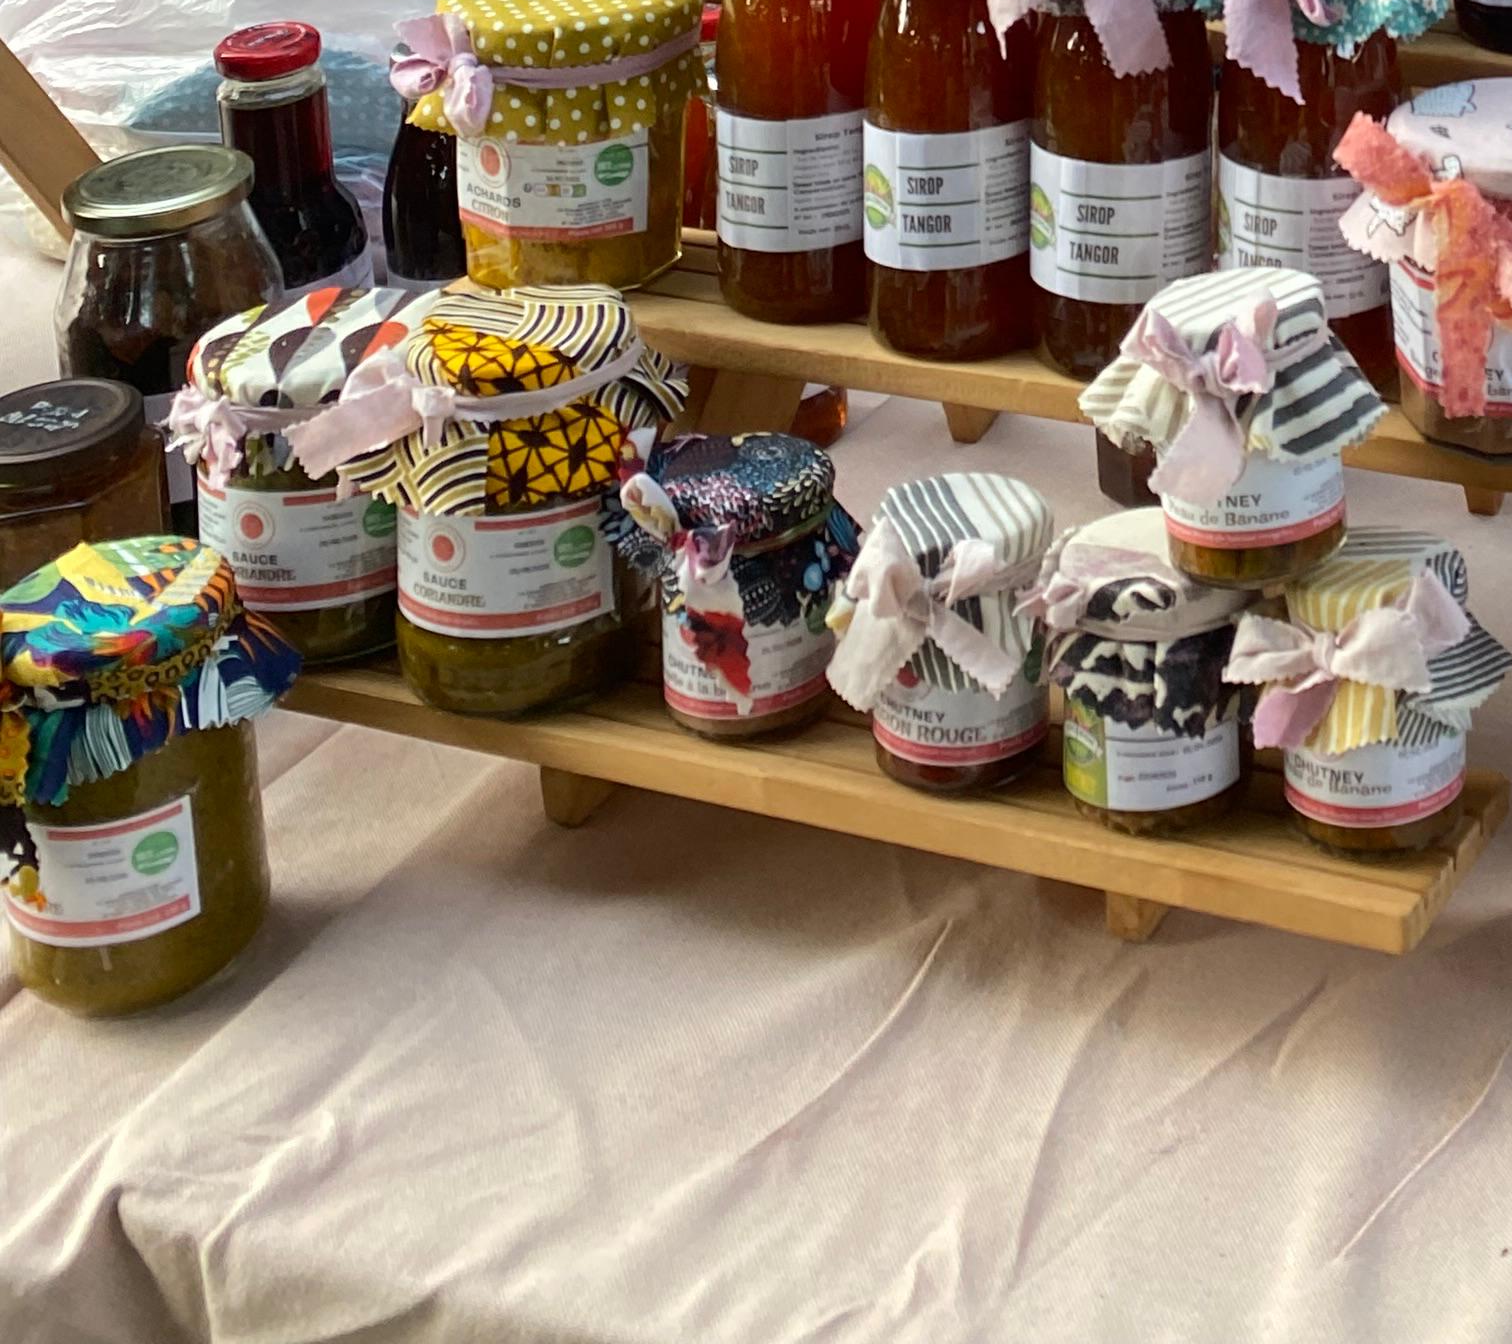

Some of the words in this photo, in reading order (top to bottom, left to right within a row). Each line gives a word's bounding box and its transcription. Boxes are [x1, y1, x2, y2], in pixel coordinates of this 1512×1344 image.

[728, 155, 759, 177] SIROP
[466, 181, 522, 209] ACHARDS
[906, 175, 945, 195] SIROP
[725, 190, 766, 216] TANGOR
[1076, 203, 1116, 226] SIROP
[901, 213, 953, 234] TANGOR
[1243, 211, 1278, 238] SIROP
[1069, 241, 1120, 265] TANGOR
[1199, 509, 1219, 526] de
[1225, 509, 1290, 527] Banane
[232, 551, 279, 566] SAUCE
[422, 571, 468, 591] SAUCE
[413, 582, 487, 609] CORIANDRE
[1294, 753, 1365, 785] CHUTNEY
